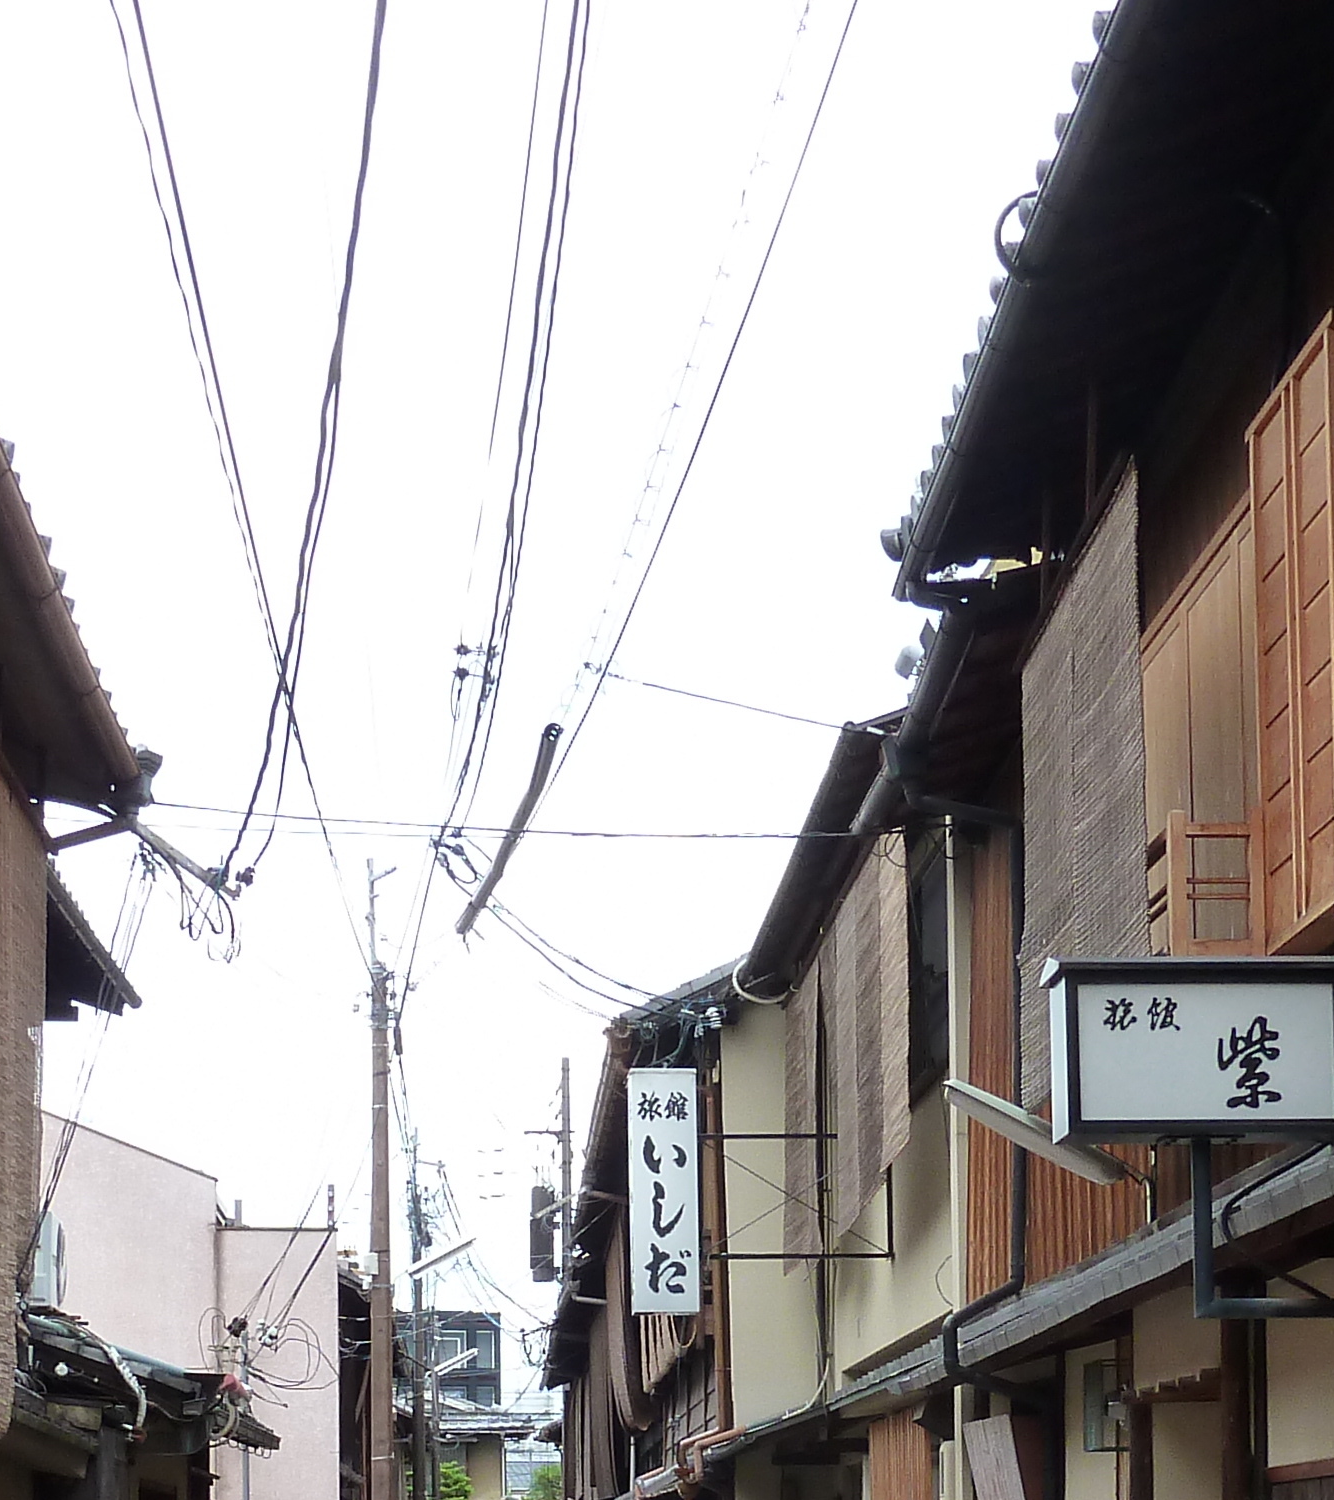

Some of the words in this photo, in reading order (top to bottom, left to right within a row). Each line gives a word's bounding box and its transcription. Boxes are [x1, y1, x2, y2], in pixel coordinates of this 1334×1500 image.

[637, 1090, 689, 1122] 旅館
[1217, 1015, 1282, 1109] 紫
[642, 1135, 692, 1294] いしだ
